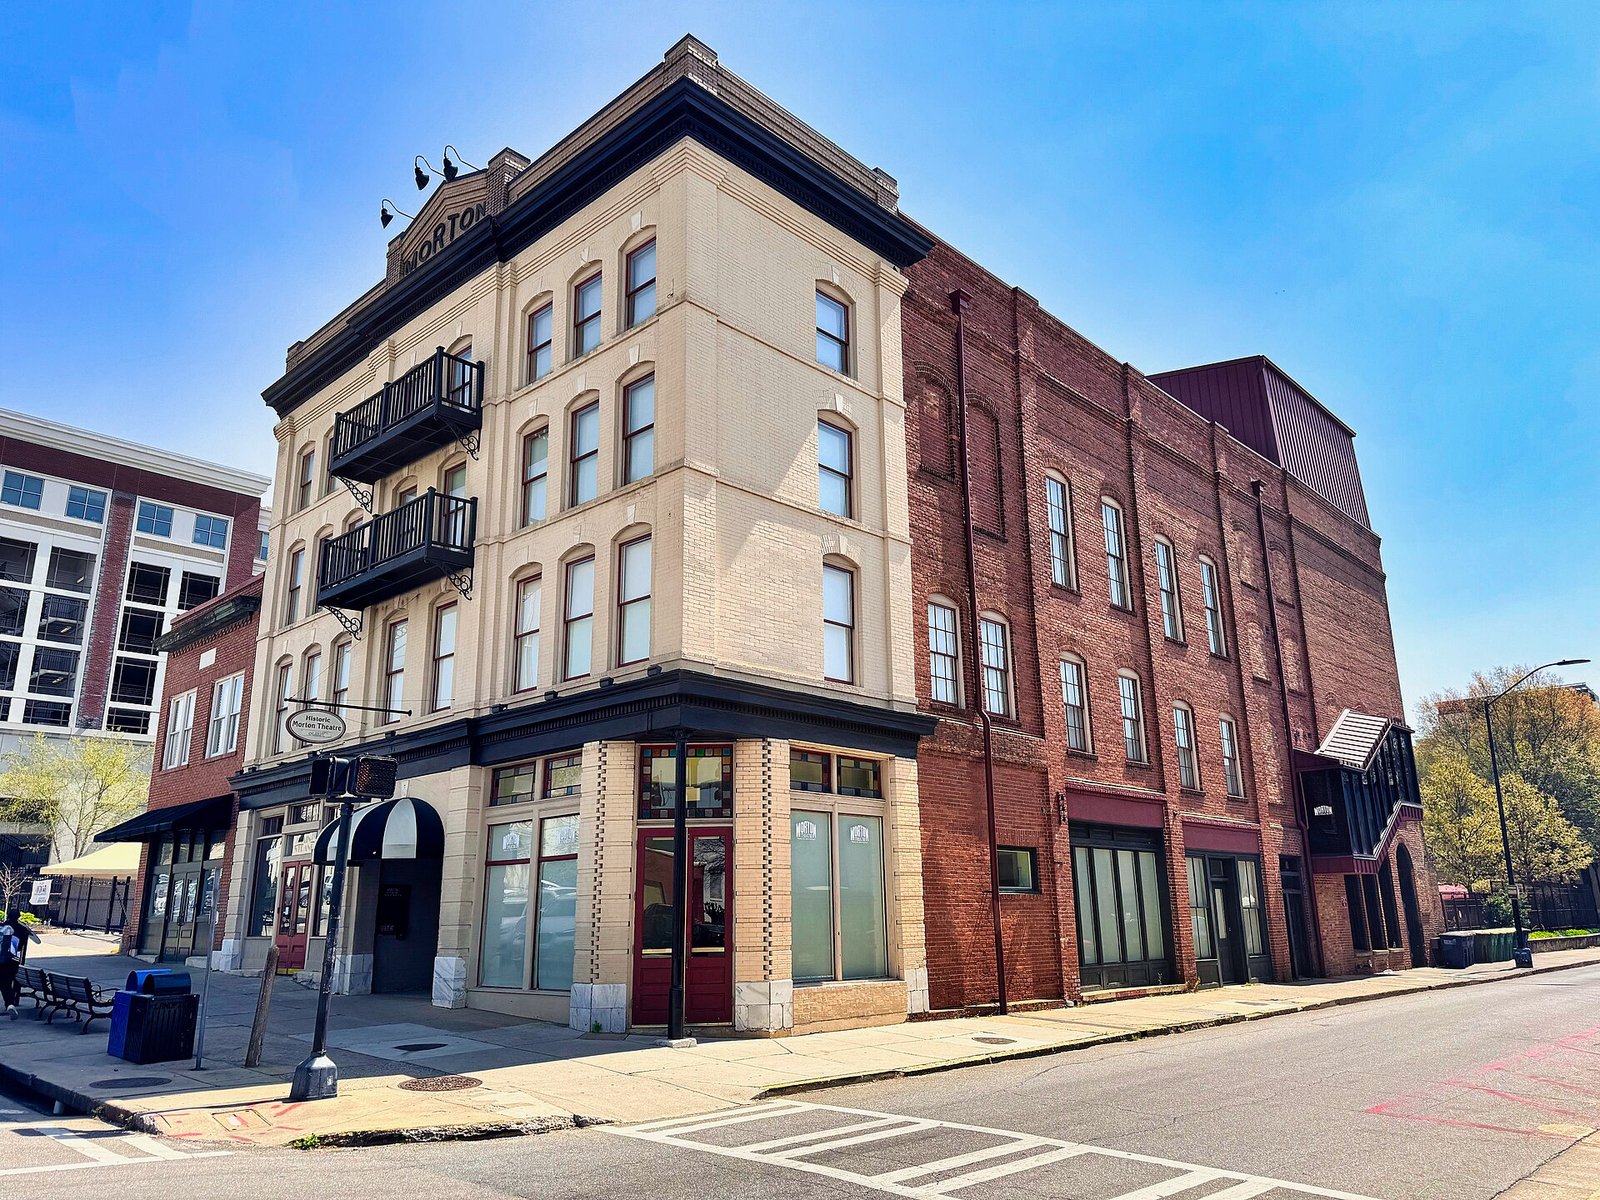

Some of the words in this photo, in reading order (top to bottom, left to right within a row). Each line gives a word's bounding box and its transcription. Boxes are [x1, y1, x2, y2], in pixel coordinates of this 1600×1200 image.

[404, 201, 487, 276] MORTON
[305, 715, 331, 723] Historic
[292, 720, 316, 729] Morton
[317, 723, 342, 732] Theatre
